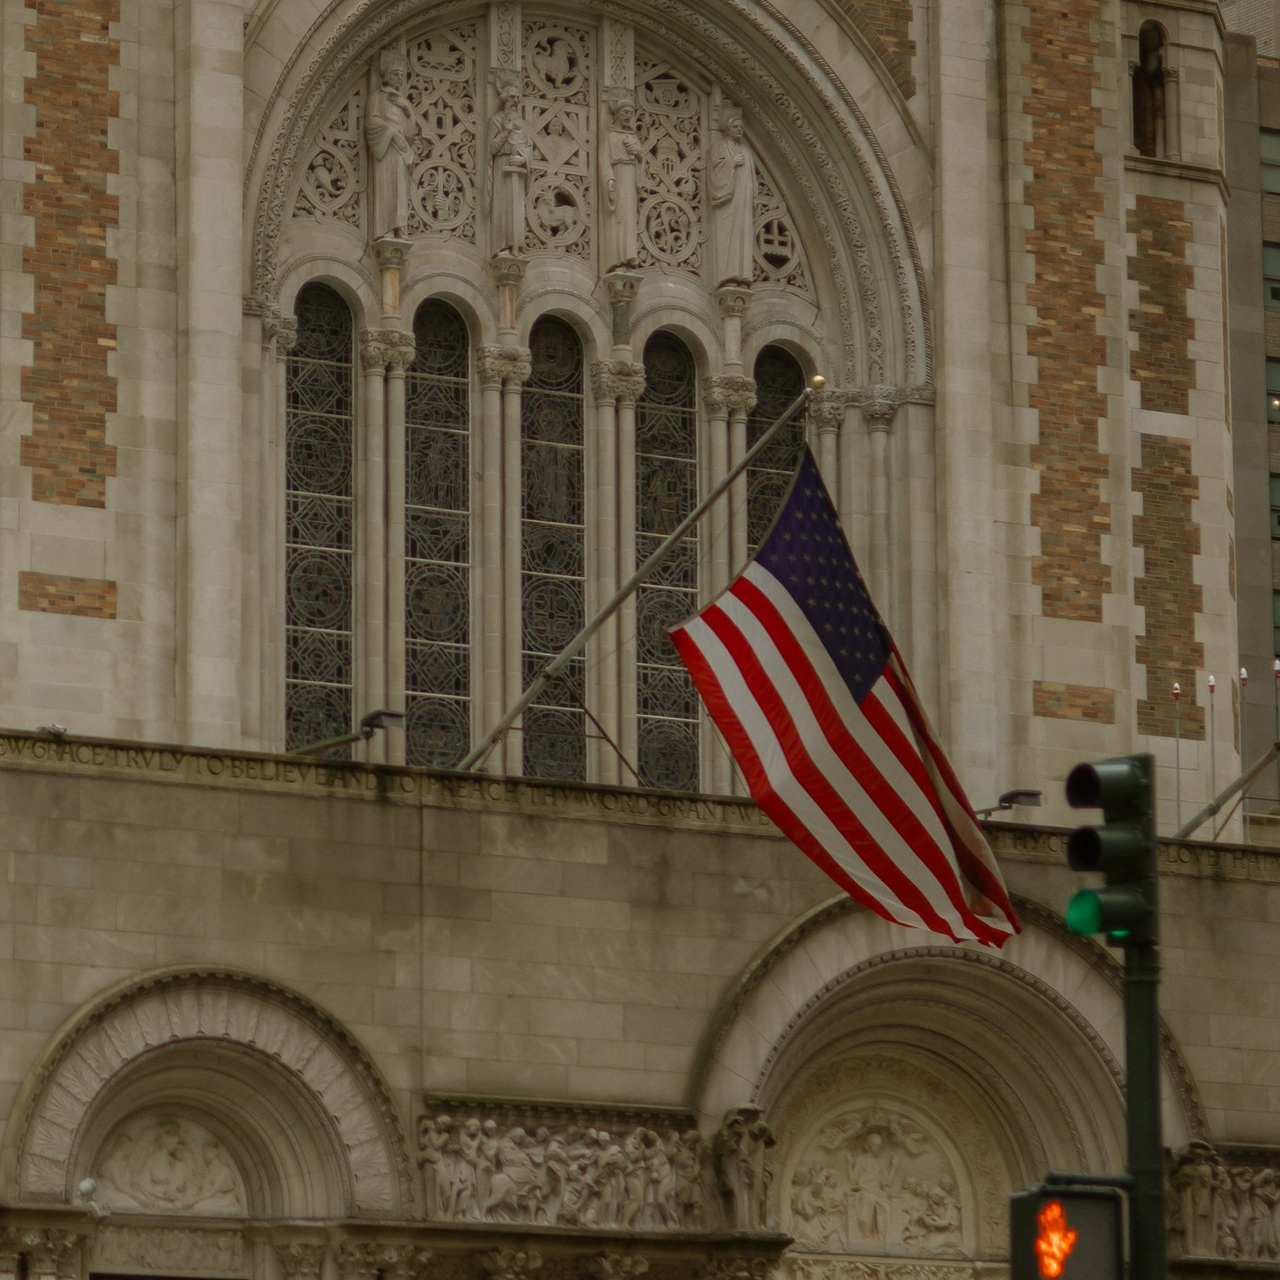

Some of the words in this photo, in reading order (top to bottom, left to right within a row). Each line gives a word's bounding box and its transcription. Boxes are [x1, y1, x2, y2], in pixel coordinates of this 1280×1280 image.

[31, 739, 105, 767] GRACE
[193, 755, 224, 776] TO
[230, 757, 328, 786] BELIEVE
[329, 767, 378, 791] AND
[386, 774, 417, 794] TO
[425, 776, 520, 804] PREACH
[526, 786, 572, 808] THY
[578, 789, 649, 815] WORD
[656, 796, 731, 822] GRANT
